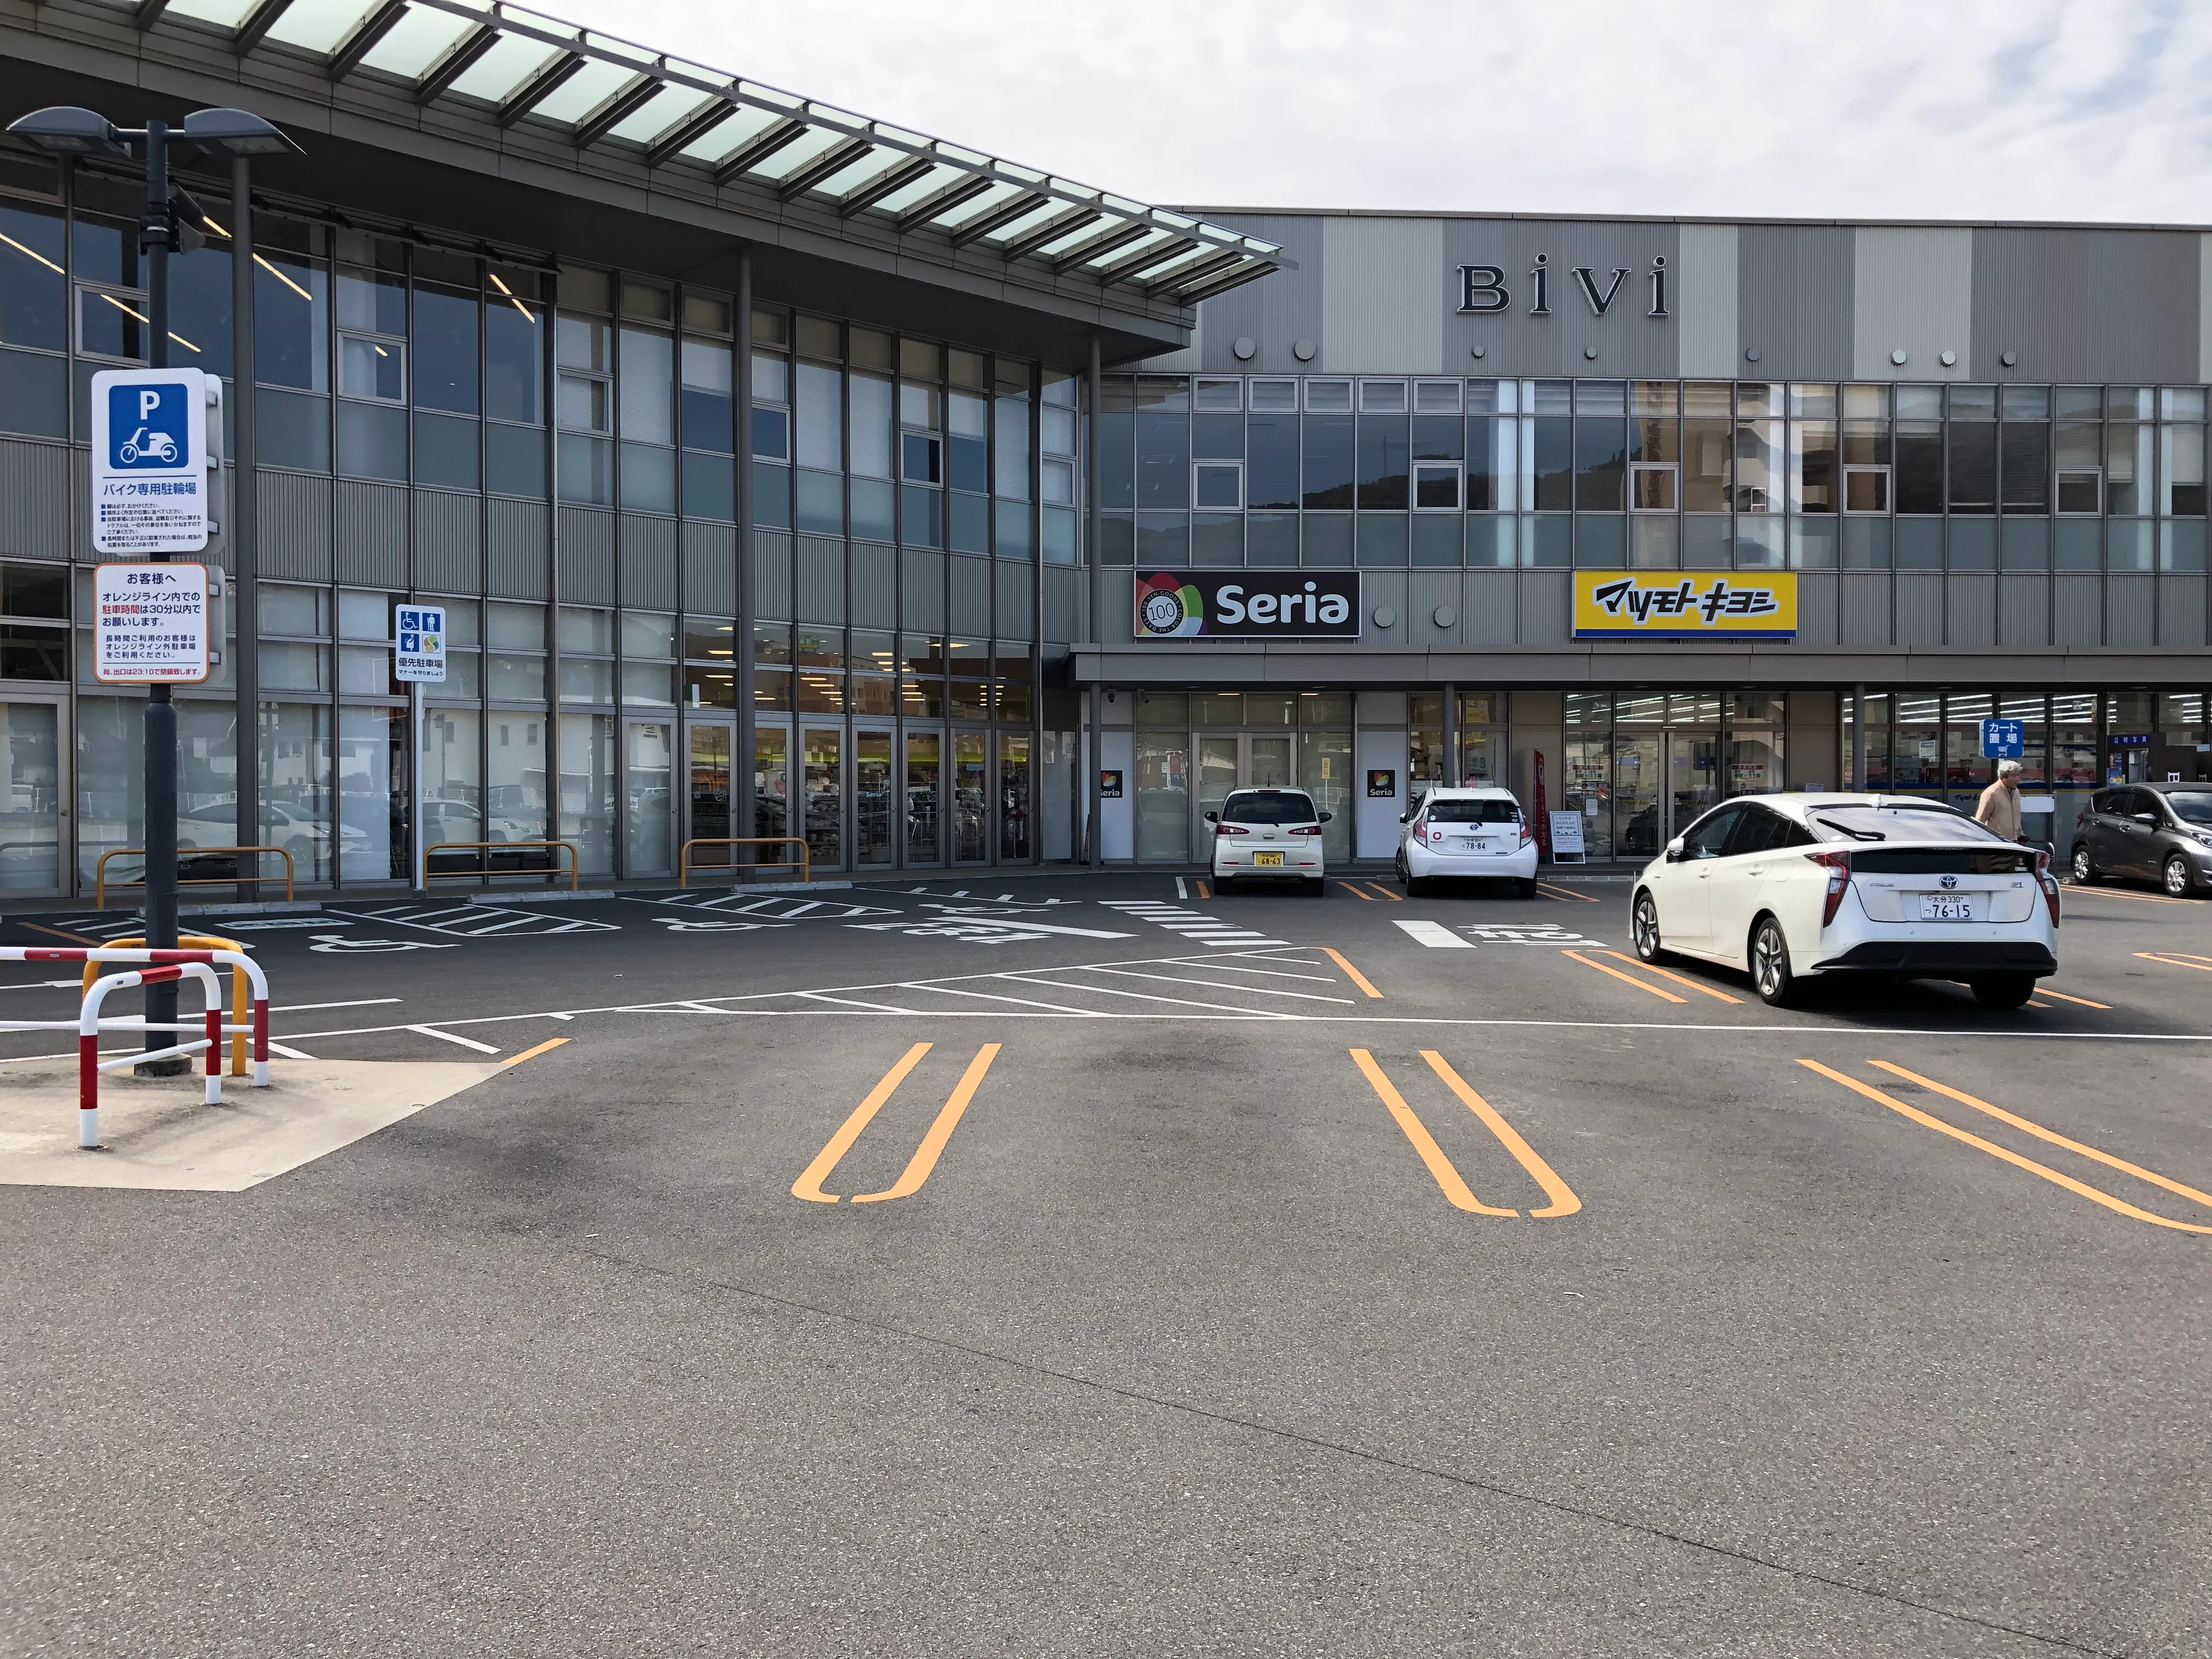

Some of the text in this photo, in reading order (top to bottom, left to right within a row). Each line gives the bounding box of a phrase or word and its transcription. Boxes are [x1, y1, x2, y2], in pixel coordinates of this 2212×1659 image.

[1457, 253, 1670, 315] BiVi
[139, 390, 160, 420] P
[103, 482, 196, 496] バイク専用駐輪場
[127, 573, 176, 584] お客様へ
[102, 591, 200, 602] オレンジライン内での
[1147, 591, 1158, 600] YEN
[1160, 591, 1180, 604] GOODS
[1595, 579, 1778, 623] マツモトキヨシ
[1216, 581, 1349, 624] Seria
[102, 605, 201, 614] 駐車時間は30分以内で
[1148, 602, 1175, 621] 100
[103, 617, 164, 627] お願いします。
[1143, 618, 1157, 631] DAYS
[1171, 610, 1183, 628] COLOR
[105, 634, 196, 642] 長時間ご利用のお客様は
[398, 657, 443, 669] 優先駐車場
[1989, 722, 2018, 732] カート
[1989, 733, 2018, 744] 置場
[1370, 788, 1393, 796] Seria
[1932, 904, 1970, 917] 76-15
